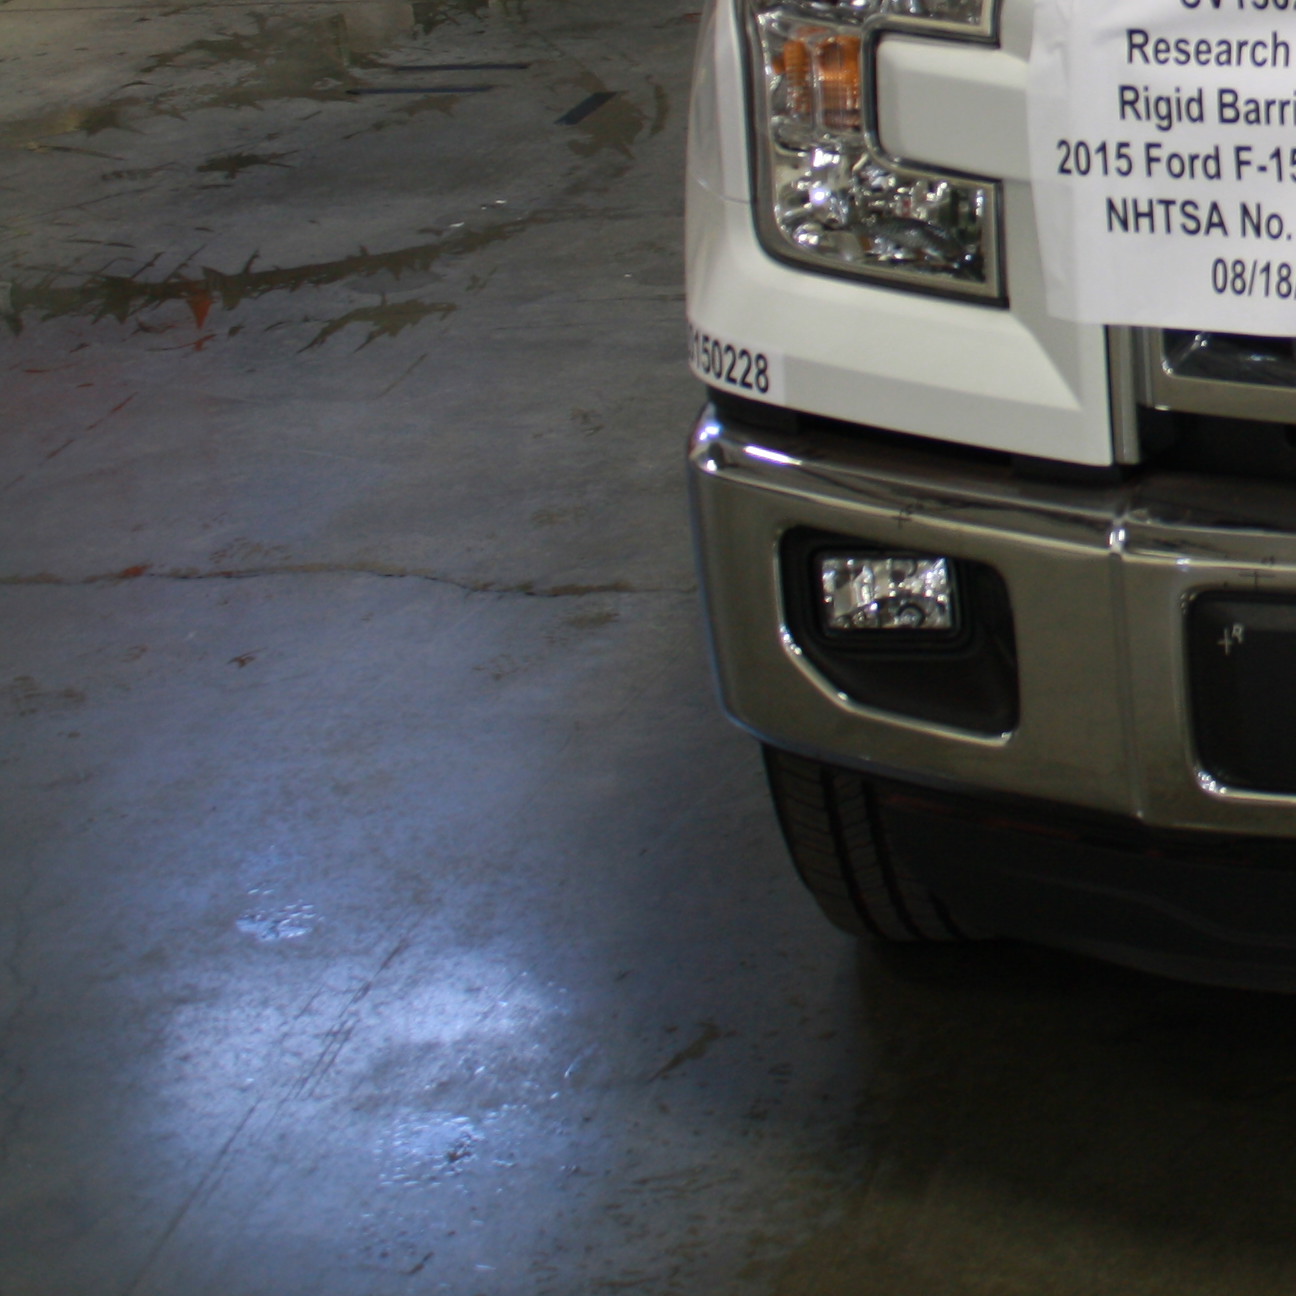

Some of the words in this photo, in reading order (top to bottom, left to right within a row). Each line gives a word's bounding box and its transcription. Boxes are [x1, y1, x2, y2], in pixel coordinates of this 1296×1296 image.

[1126, 28, 1290, 68] Research
[1118, 85, 1205, 132] Rigid
[1057, 139, 1133, 177] 2015
[1145, 142, 1222, 181] Ford
[1106, 198, 1229, 238] NHTSA
[1240, 203, 1293, 241] No.
[690, 327, 769, 394] 150228
